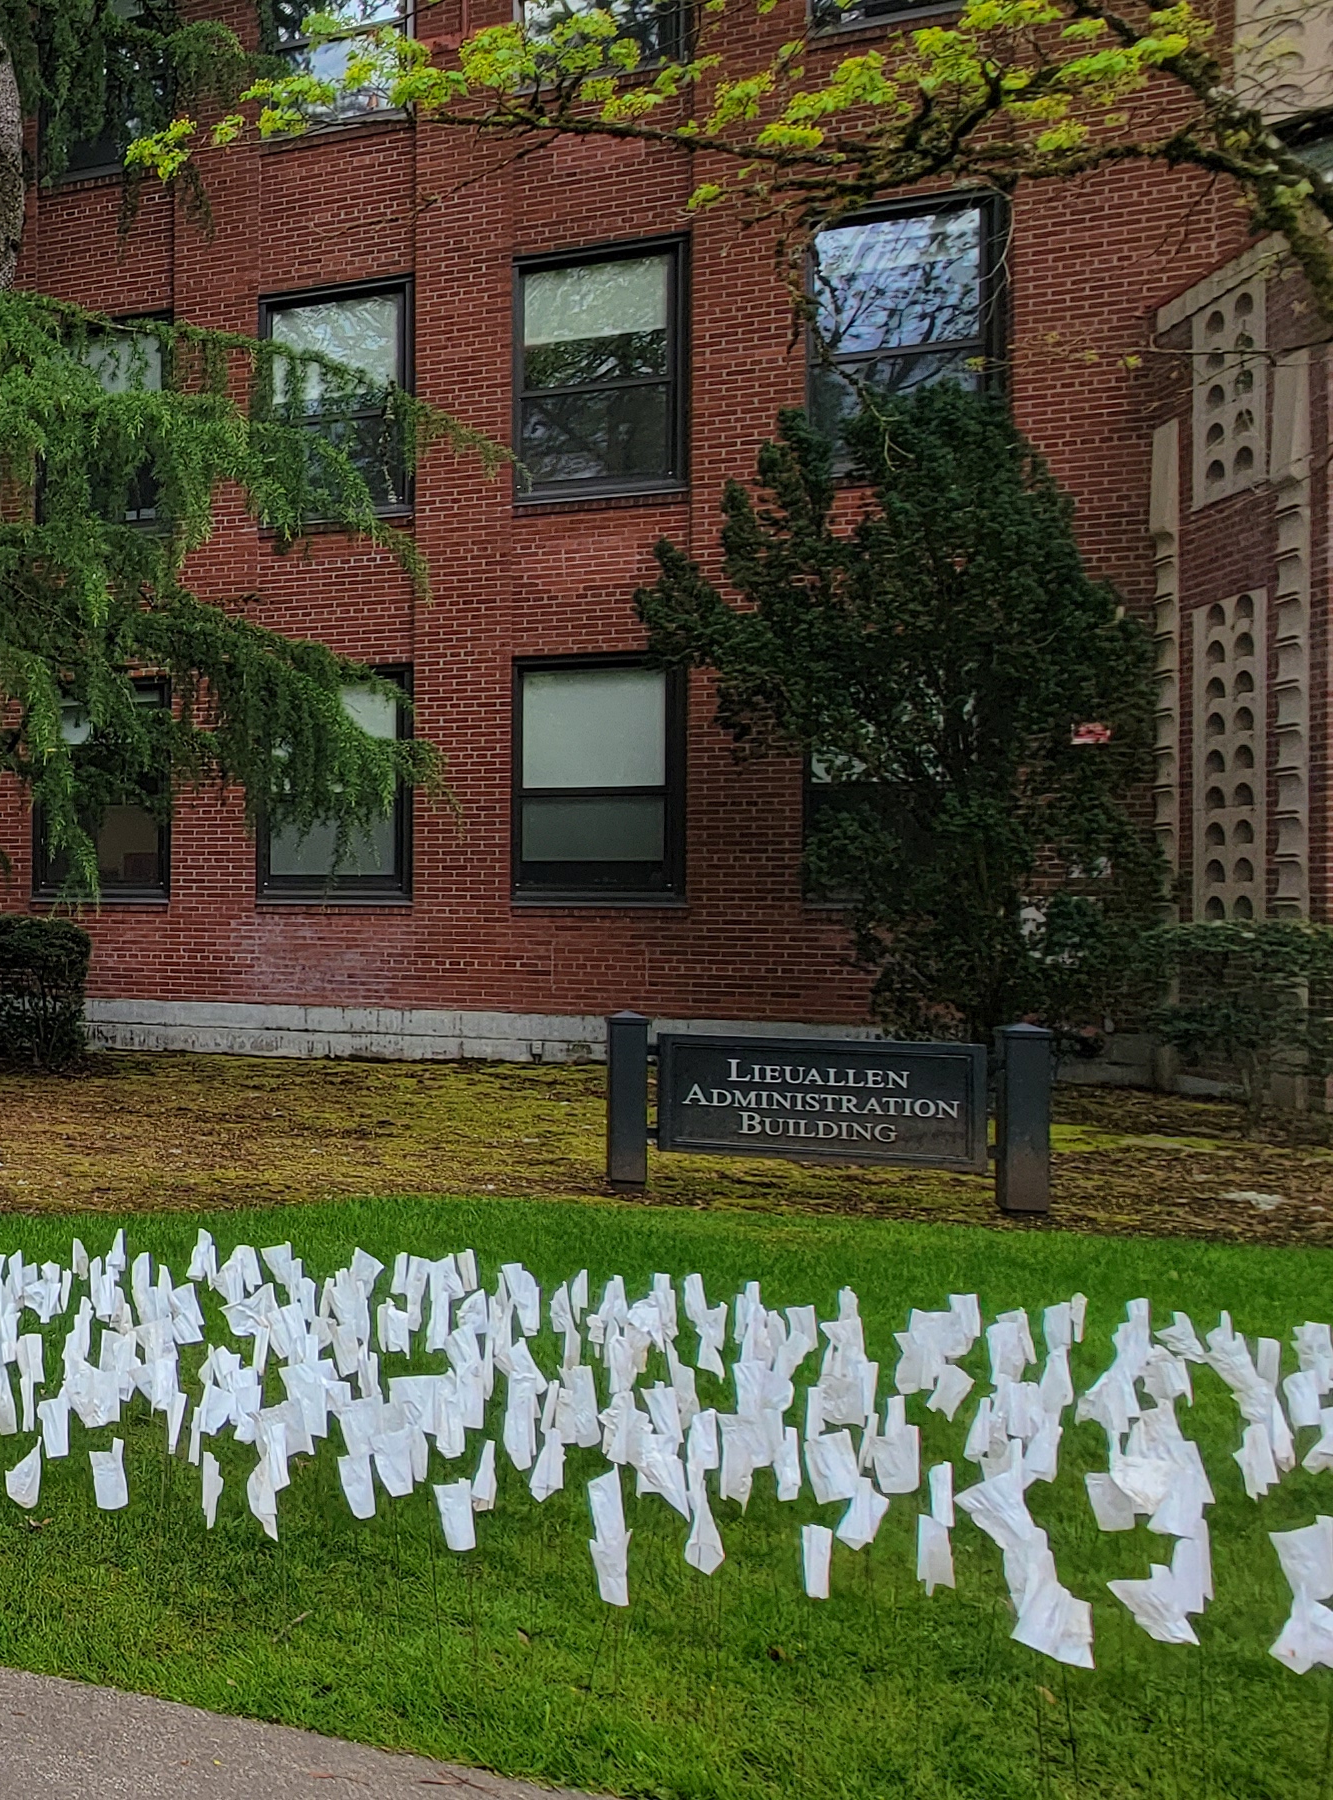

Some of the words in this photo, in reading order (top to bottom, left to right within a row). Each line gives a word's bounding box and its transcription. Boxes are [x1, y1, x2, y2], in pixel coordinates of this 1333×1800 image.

[726, 1058, 910, 1089] LIEUALLEN
[682, 1083, 961, 1119] ADMINISTRATION
[738, 1111, 898, 1143] BUILDING
